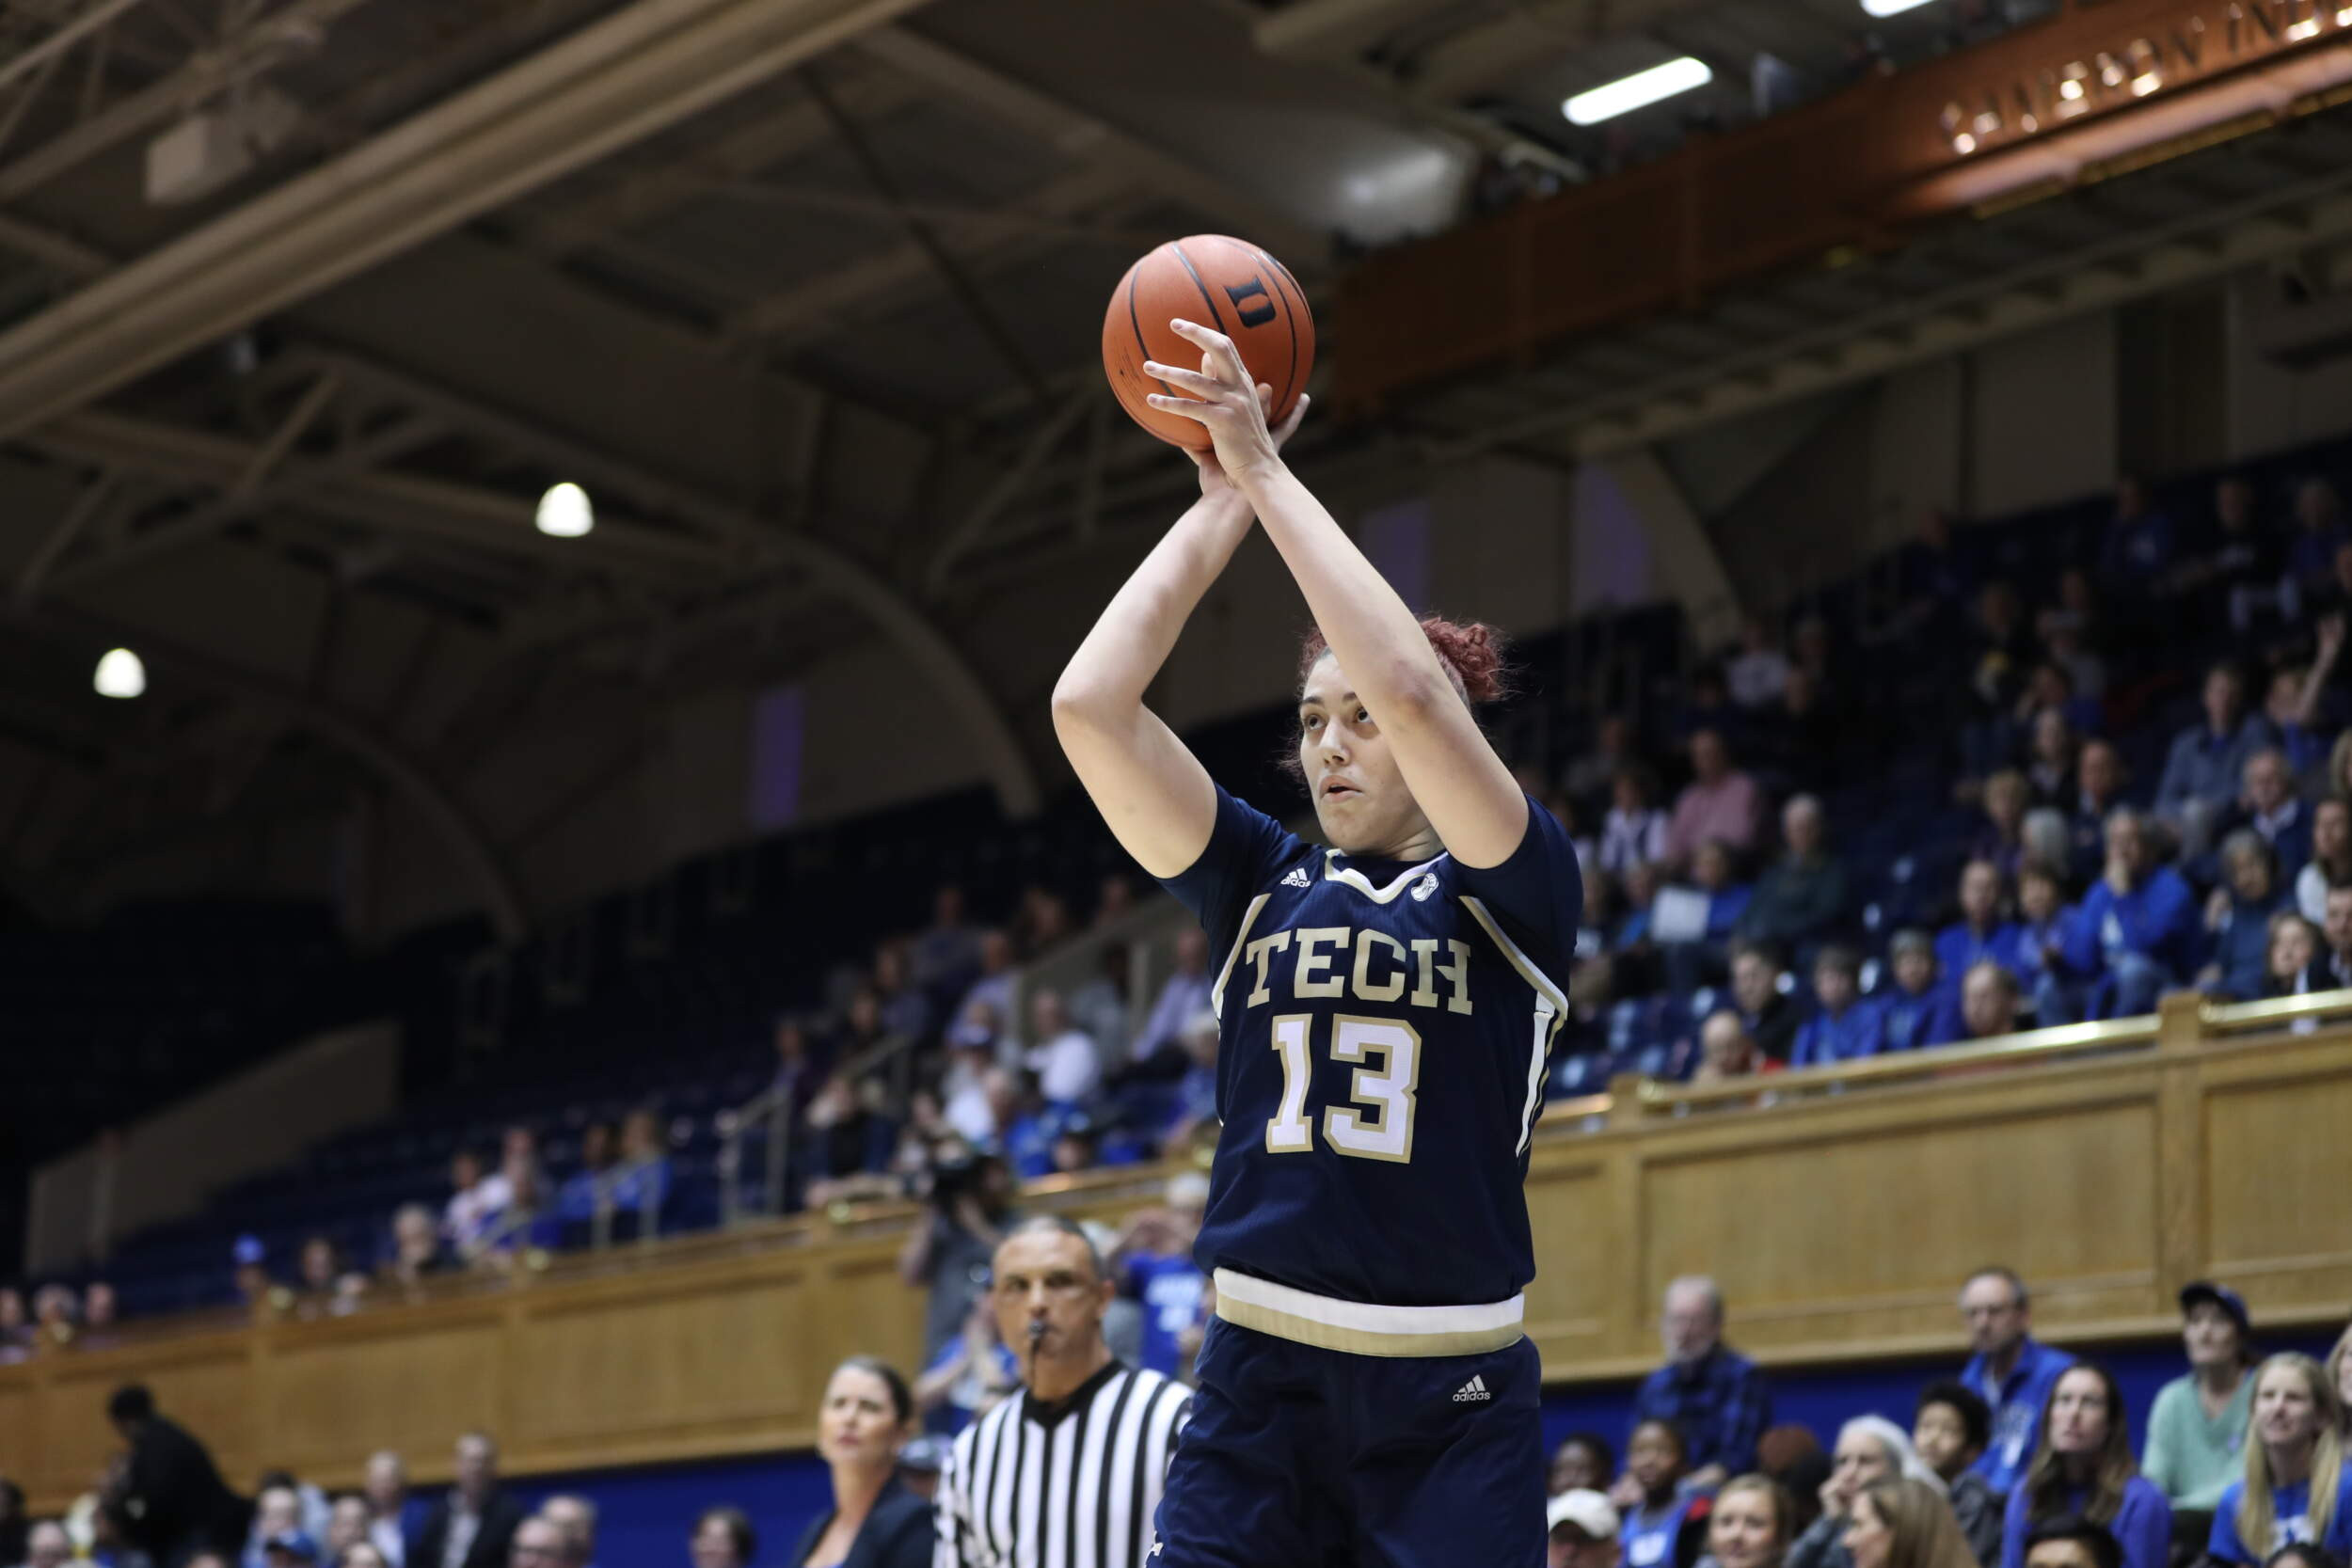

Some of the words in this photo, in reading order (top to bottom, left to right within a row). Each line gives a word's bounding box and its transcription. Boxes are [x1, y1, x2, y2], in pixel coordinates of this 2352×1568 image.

[1280, 875, 1311, 888] adidas
[1247, 927, 1472, 1015] TECH
[1266, 1013, 1422, 1164] 13
[1453, 1391, 1491, 1402] adidas
